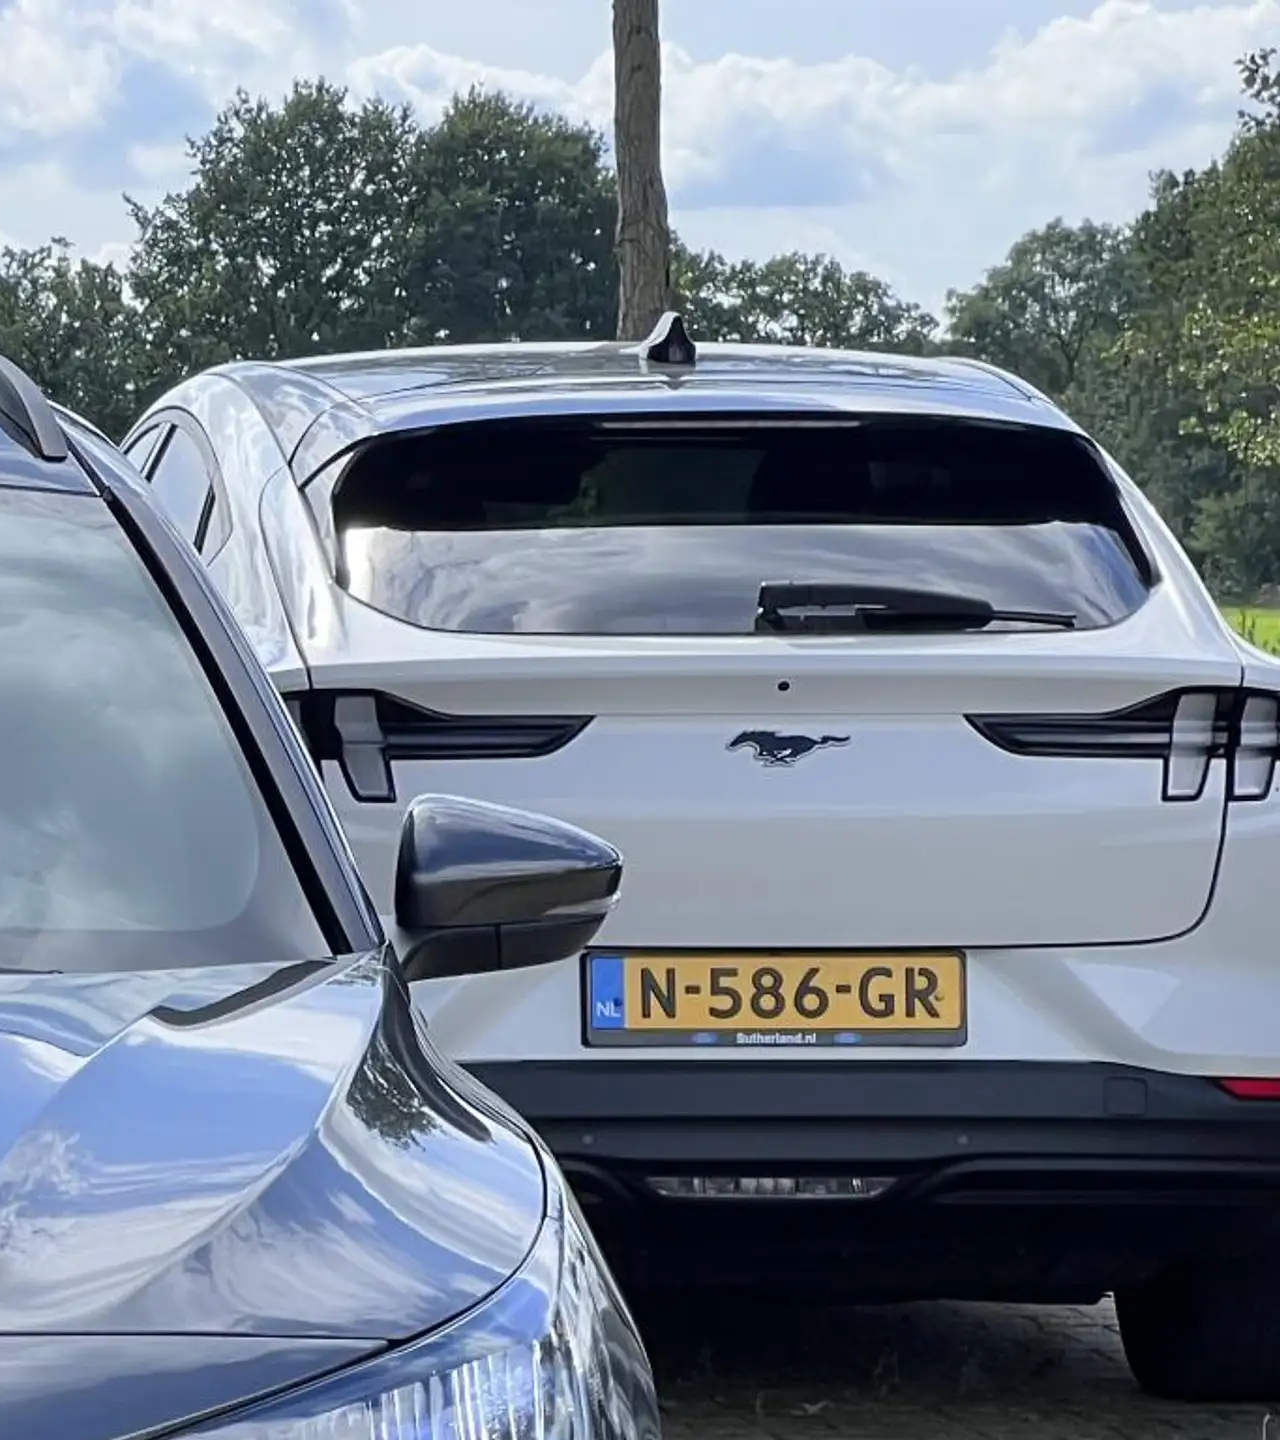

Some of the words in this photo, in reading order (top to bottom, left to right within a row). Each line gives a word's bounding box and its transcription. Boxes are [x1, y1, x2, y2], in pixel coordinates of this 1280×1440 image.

[640, 967, 941, 1020] N-586-GR
[596, 1002, 622, 1017] NL
[736, 1032, 817, 1045] Sutherland.nl
